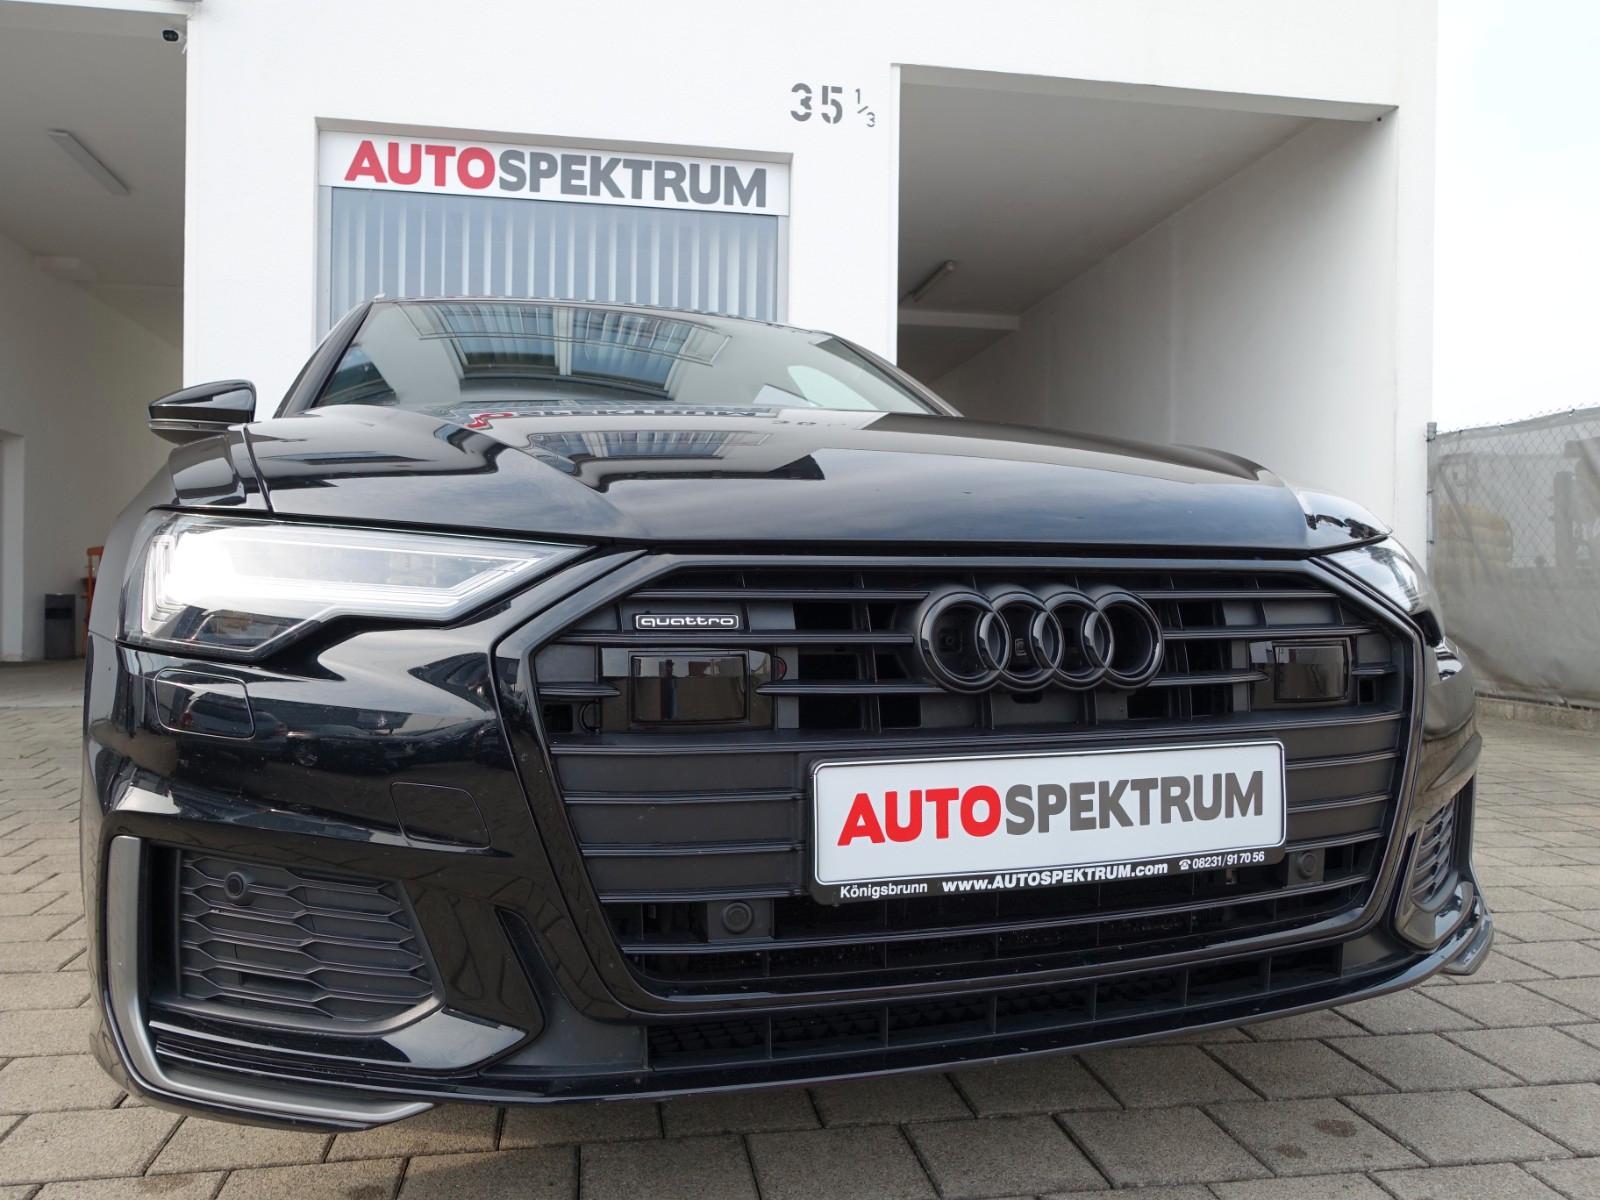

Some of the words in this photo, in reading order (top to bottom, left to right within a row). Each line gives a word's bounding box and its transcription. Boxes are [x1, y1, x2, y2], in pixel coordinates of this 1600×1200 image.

[790, 82, 843, 125] 35
[344, 139, 767, 208] AUTOSPEKTRUM
[640, 616, 734, 628] quattro
[836, 770, 1264, 847] AUTOSPEKTRUM
[840, 882, 928, 899] Königsbrunn
[942, 862, 1168, 893] www.AUTOSPEKTRUM.com
